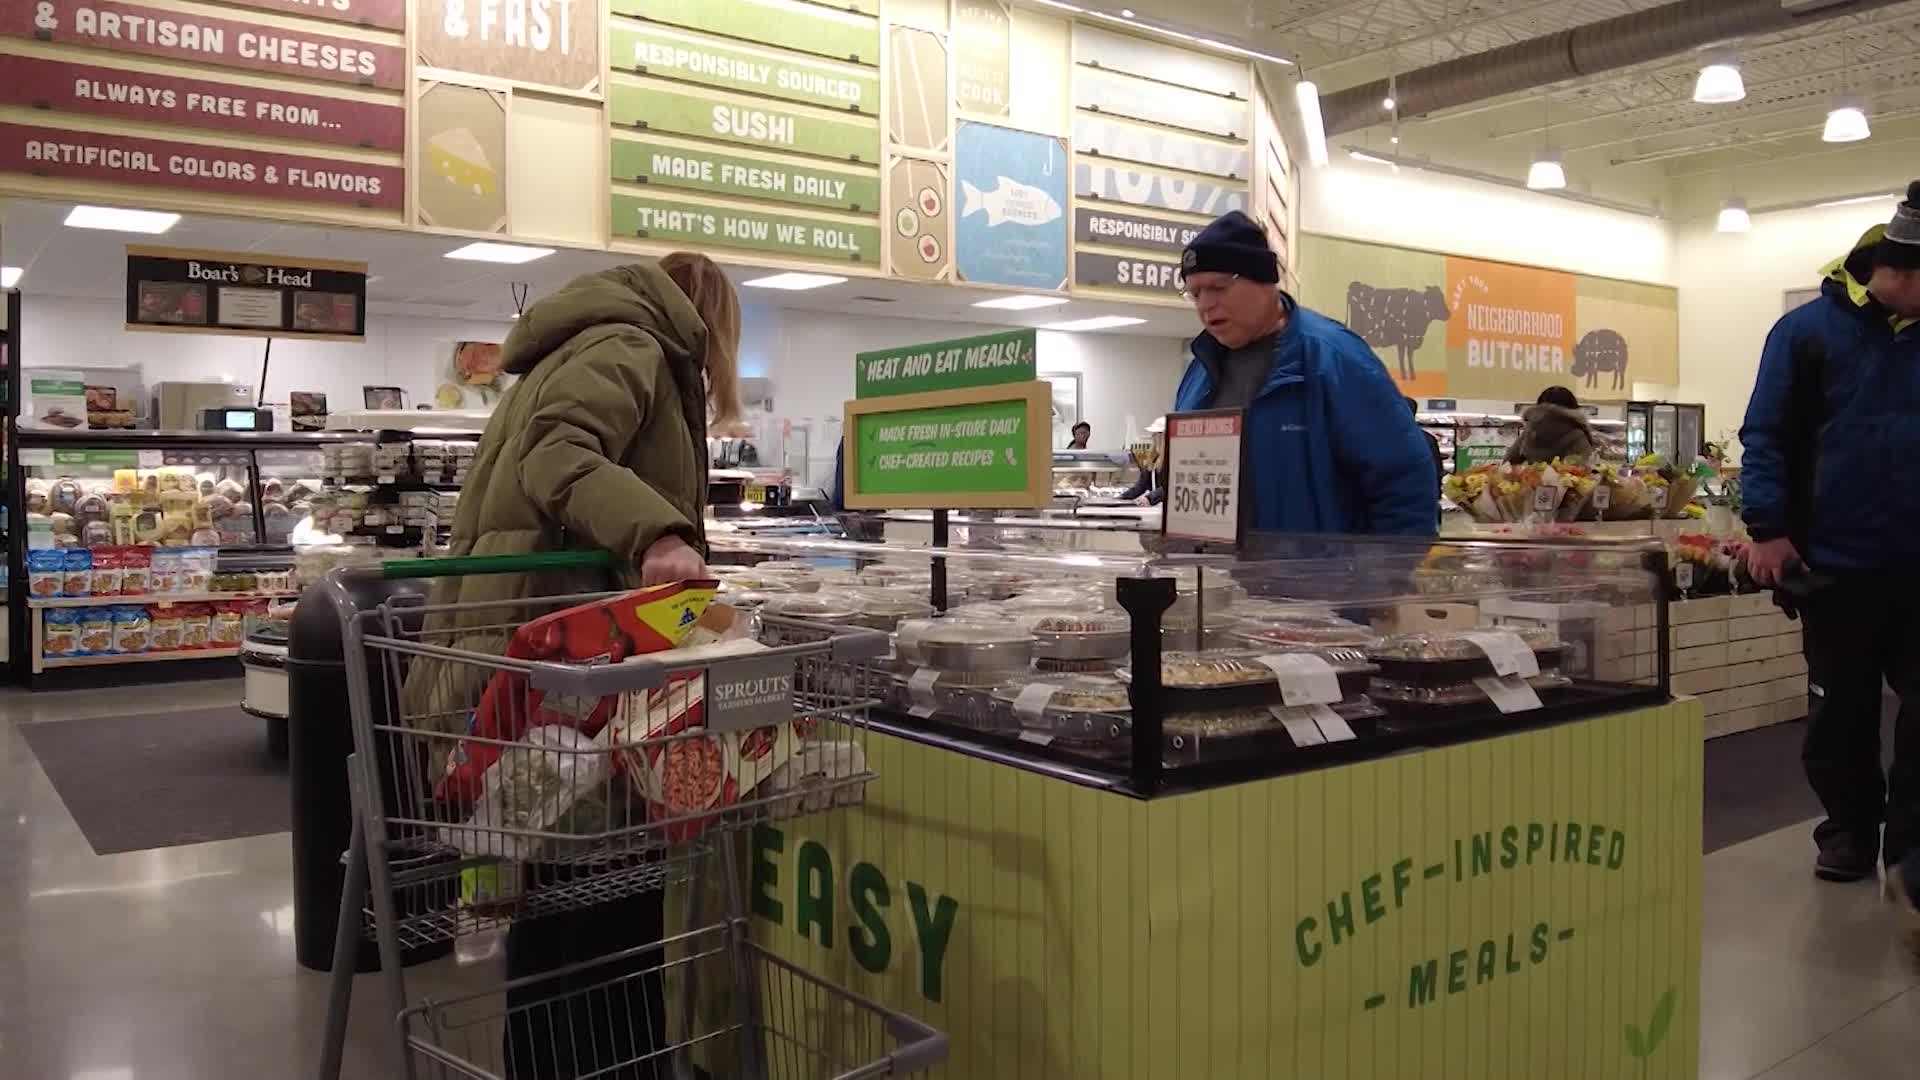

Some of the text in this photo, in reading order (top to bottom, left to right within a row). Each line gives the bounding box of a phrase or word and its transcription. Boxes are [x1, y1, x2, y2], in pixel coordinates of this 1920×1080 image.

[34, 1, 376, 76] & ARTISAN CHEESES
[444, 0, 575, 55] & FAST
[633, 41, 863, 101] RESPONSIBLY SOURCED
[75, 79, 342, 129] ALWAYS FREE FROM...
[711, 104, 795, 145] SUSHI
[25, 140, 382, 194] ARTIFICIAL COLORS & FLAVORS
[652, 154, 847, 200] MADE FRESH DAILY
[637, 206, 860, 251] THAT'S HOW WE ROLL
[1089, 216, 1177, 244] RESPONSIBLY
[187, 262, 313, 288] Boar's Head
[1467, 303, 1564, 340] NEIGHBORHOOD
[867, 340, 1023, 381] HEAT AND EAT MEALS!
[1467, 338, 1564, 374] BUTCHER
[879, 417, 1021, 442] MADE FRESH IN-STORE DAILY
[879, 449, 994, 471] CHEF-CREATED RECIPES
[1174, 486, 1231, 515] 50% OFF
[714, 675, 791, 701] SPROUTS
[751, 824, 959, 1003] EASY
[1295, 822, 1625, 967] CHEF-INSPIRED
